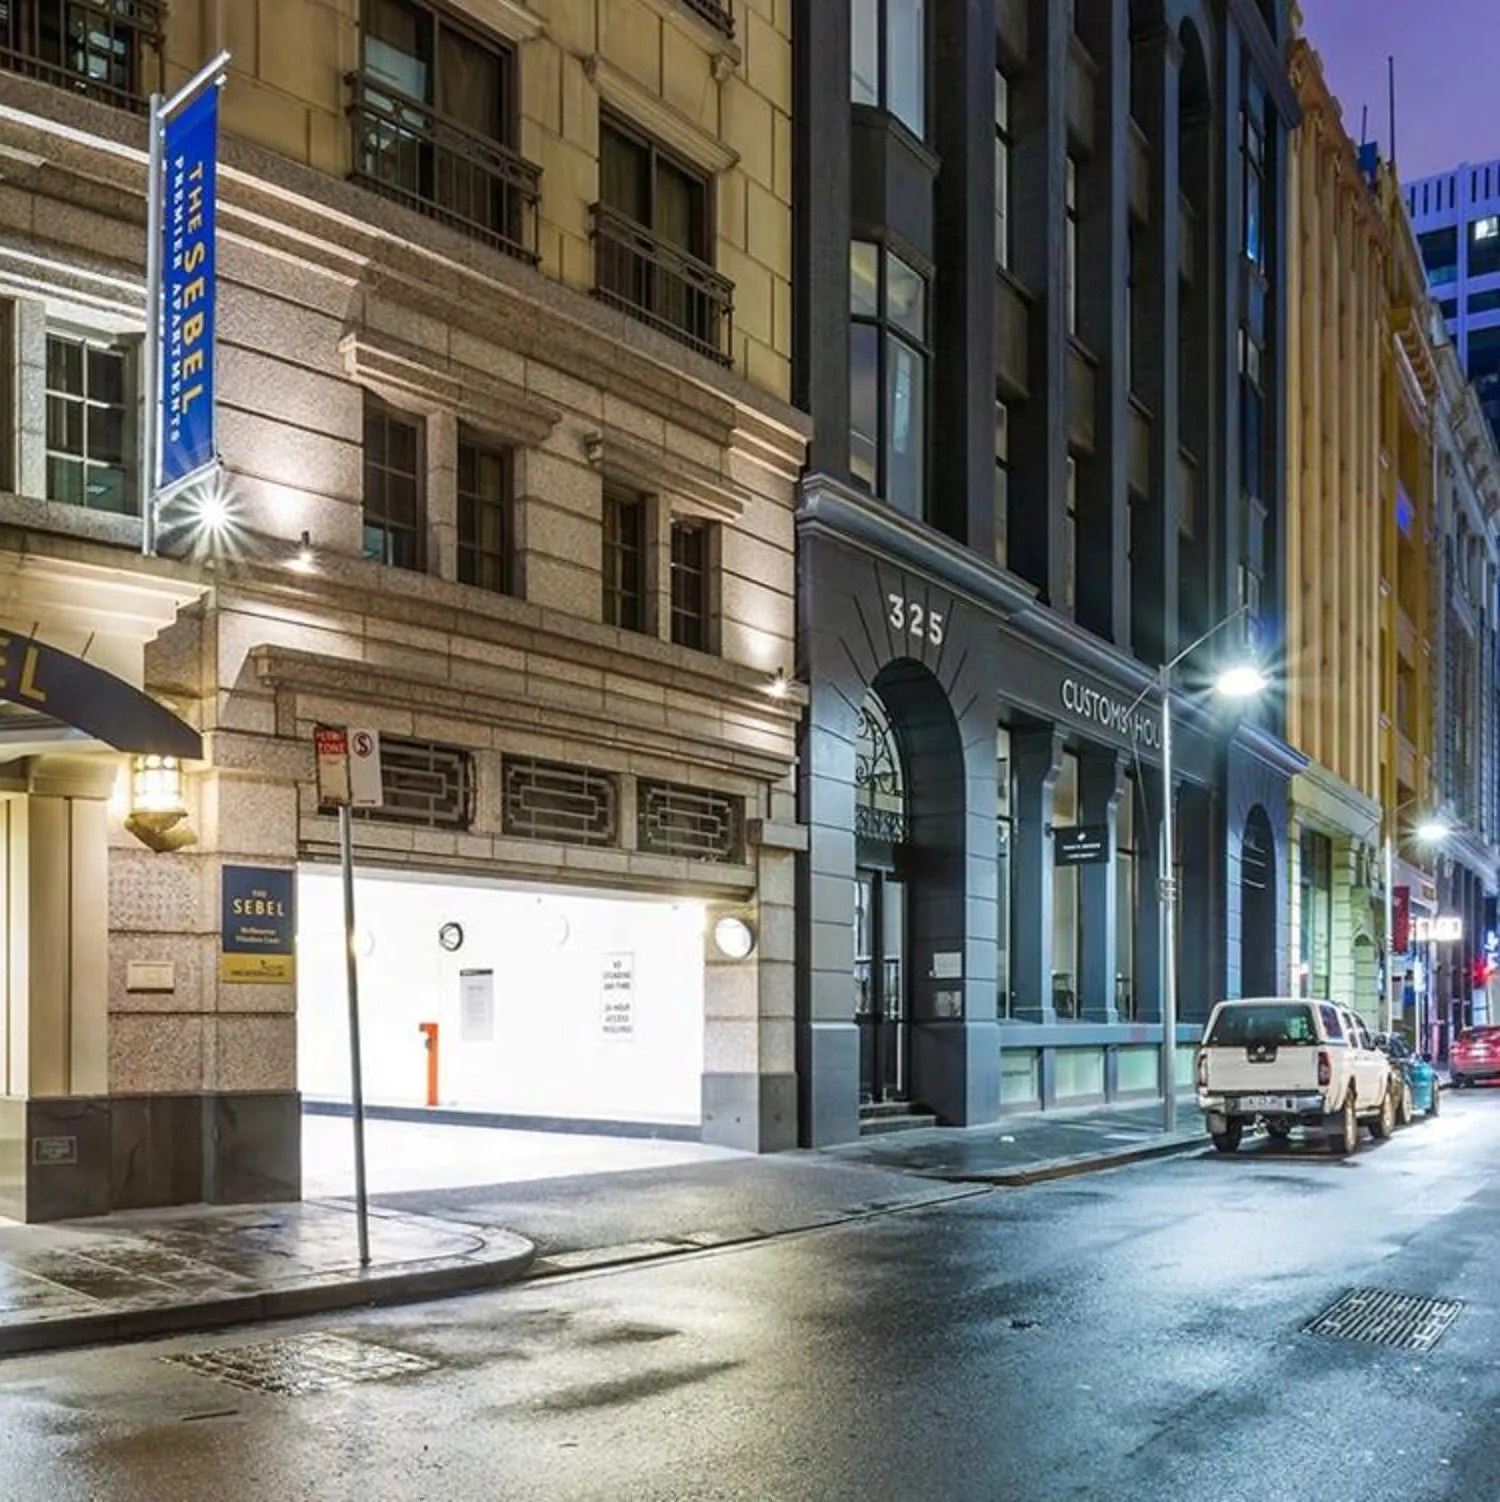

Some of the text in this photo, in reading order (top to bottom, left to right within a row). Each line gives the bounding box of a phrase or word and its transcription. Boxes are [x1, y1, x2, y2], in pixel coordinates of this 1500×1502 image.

[171, 155, 185, 443] PREMIER APARTMENTS
[182, 160, 206, 415] THE SEBEL
[888, 593, 945, 646] 325
[1062, 679, 1129, 735] CUSTOMS
[232, 898, 285, 917] SEBEL
